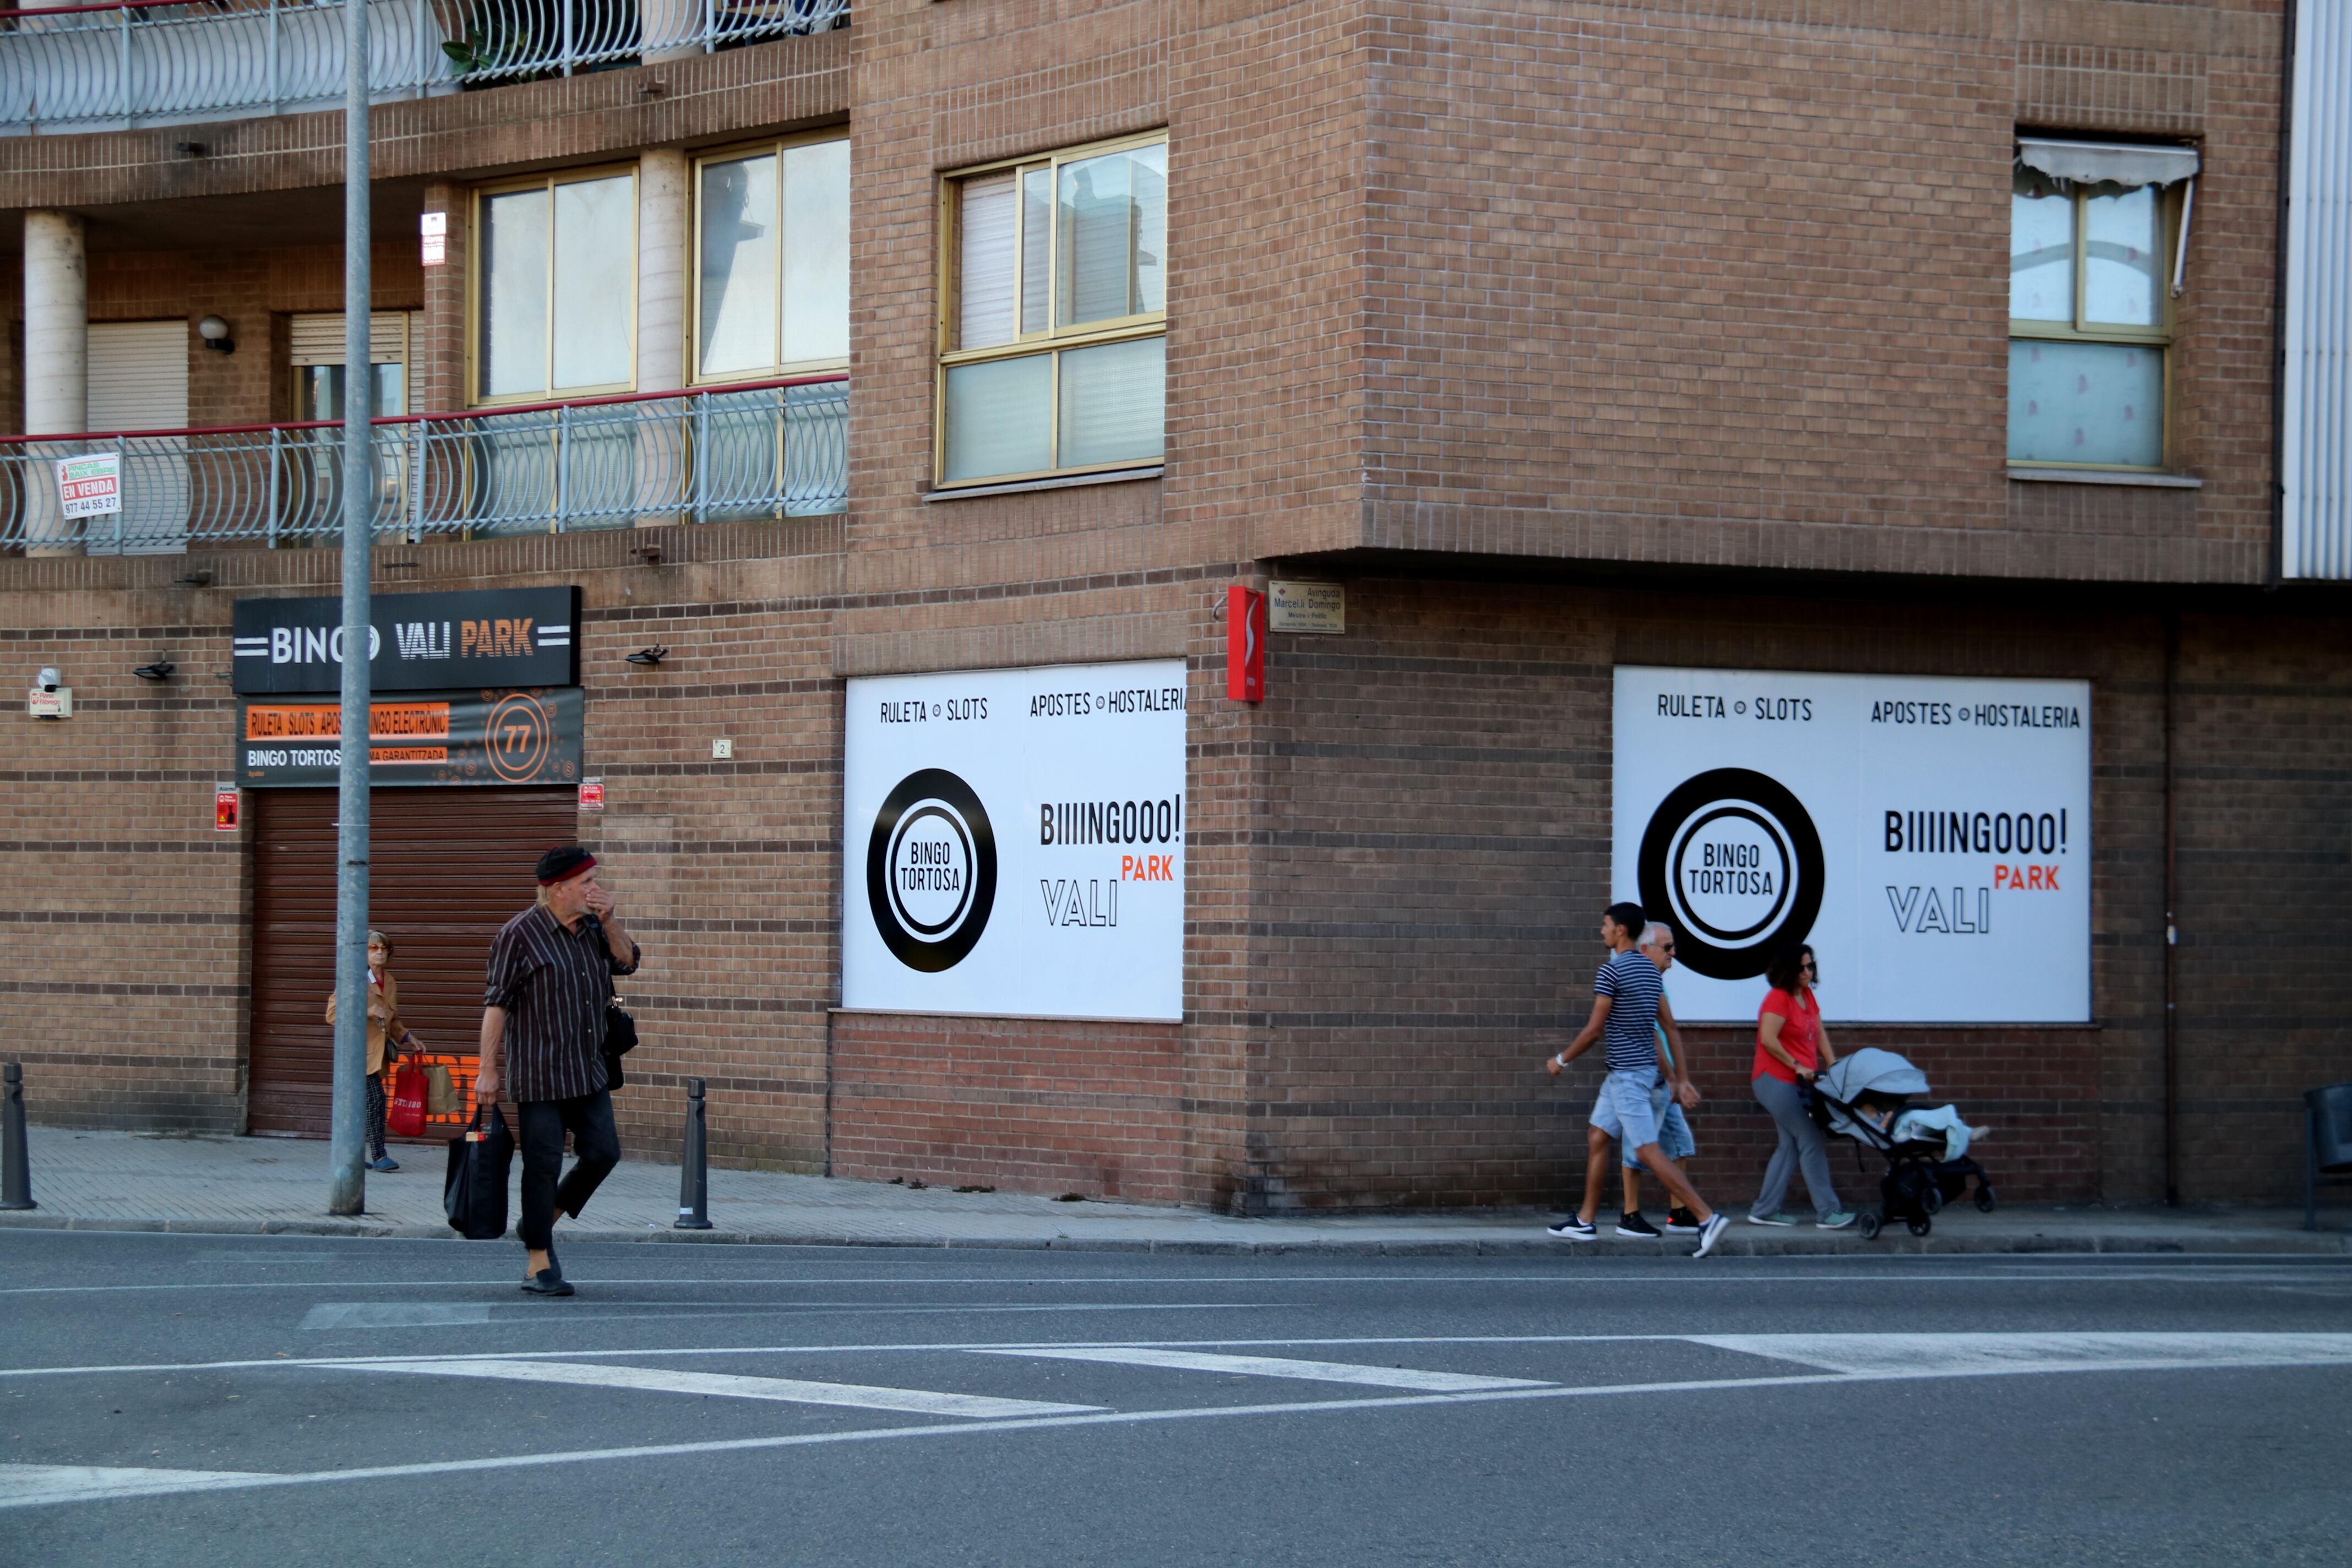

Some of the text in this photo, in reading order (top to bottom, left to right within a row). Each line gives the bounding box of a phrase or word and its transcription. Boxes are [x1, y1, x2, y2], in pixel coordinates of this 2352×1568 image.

[69, 466, 116, 479] BAIX EBRE
[63, 480, 115, 499] EN VENDA
[66, 497, 116, 514] 977 44 55 27
[1307, 587, 1340, 600] Avinguda
[1308, 598, 1341, 611] Domingo
[395, 622, 450, 660] VALI
[461, 617, 533, 658] PARK
[880, 697, 988, 723] RULETA SLOTS
[1030, 692, 1091, 717] APOSTES
[1657, 694, 1812, 721] RULETA SLOTS
[1870, 701, 2081, 728] APOSTES HOSTALERIA
[252, 712, 282, 736] RULETA
[288, 712, 315, 735] SLOTS
[503, 725, 531, 753] 77
[720, 744, 725, 754] 2
[248, 749, 341, 766] BINGO TORTOS
[383, 750, 444, 761] GARANTITZADA
[1040, 794, 1180, 845] BIIIINGOOO!
[1885, 808, 2067, 854] BIIIINGOOO!
[911, 842, 950, 864] BINGO
[1703, 843, 1760, 868] BINGO
[900, 867, 960, 891] TORTOSA
[1121, 855, 1174, 882] PARK
[1994, 865, 2060, 890] PARK
[1689, 869, 1773, 896] TORTOSA
[1040, 879, 1118, 927] VALI
[1886, 885, 1989, 934] VALI
